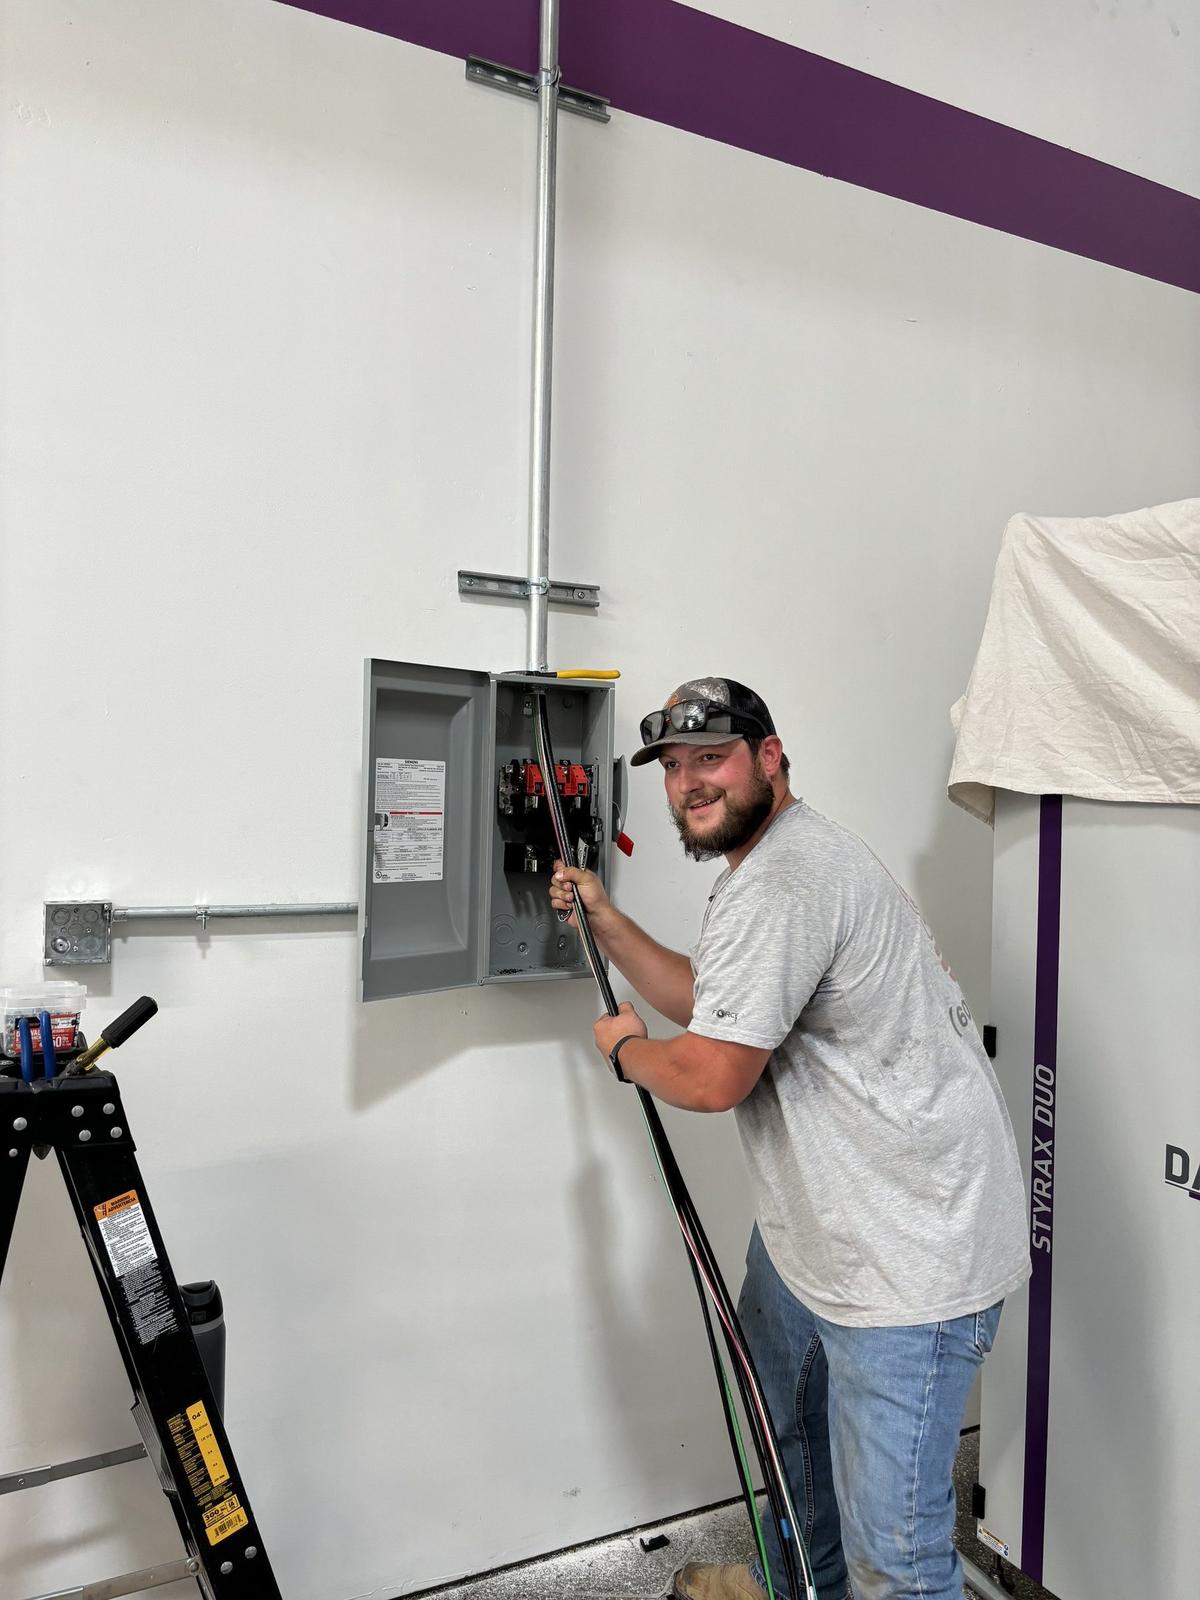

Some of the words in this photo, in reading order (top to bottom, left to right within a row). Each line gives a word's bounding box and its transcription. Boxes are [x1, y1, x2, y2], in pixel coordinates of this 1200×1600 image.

[1035, 1064, 1055, 1128] DUO
[110, 1195, 130, 1206] WARNING
[1032, 1135, 1052, 1253] STYRAX
[107, 1197, 136, 1213] ADVERTENCIA
[204, 1509, 220, 1521] 300
